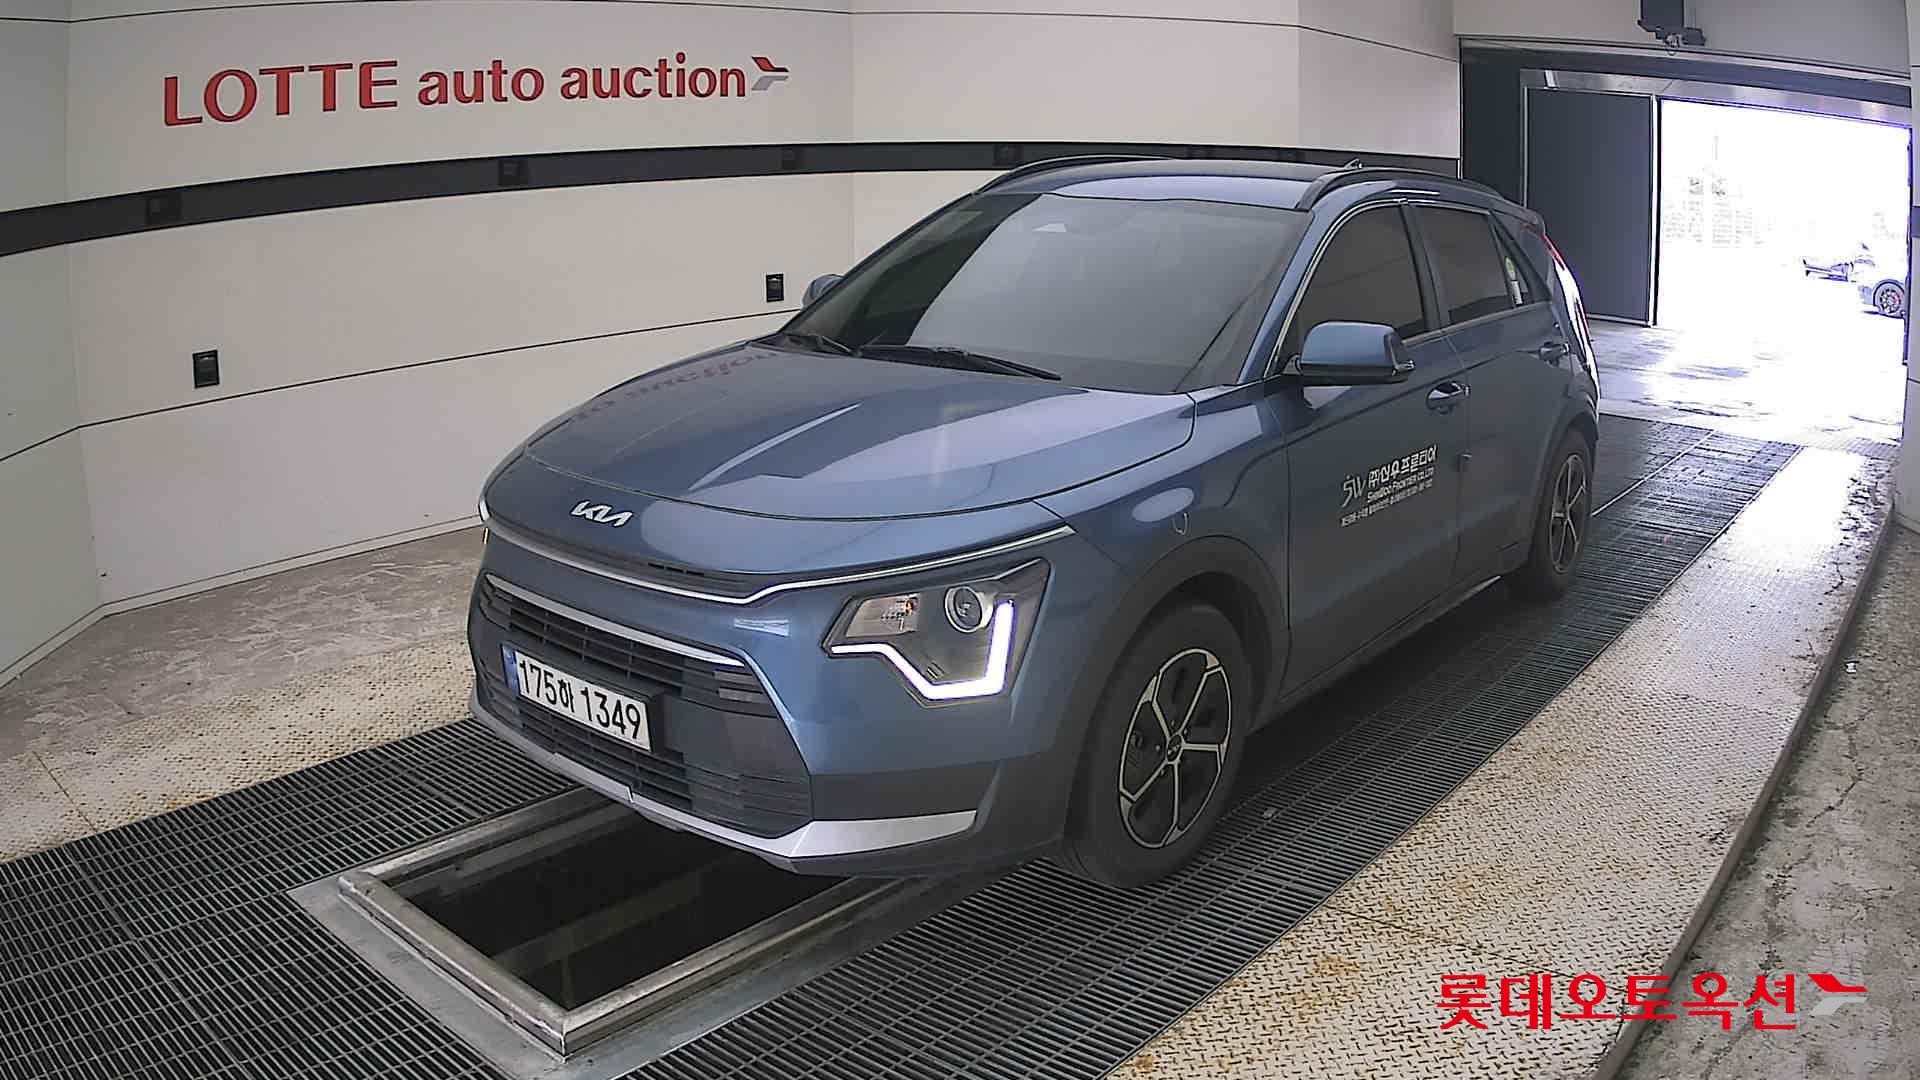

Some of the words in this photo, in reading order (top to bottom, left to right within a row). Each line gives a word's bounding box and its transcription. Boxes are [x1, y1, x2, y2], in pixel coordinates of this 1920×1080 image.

[163, 60, 399, 127] LOTTE
[417, 59, 546, 106] auto
[560, 52, 747, 99] auction
[571, 500, 633, 527] KIA
[519, 659, 574, 713] 175하
[581, 686, 642, 740] 1349
